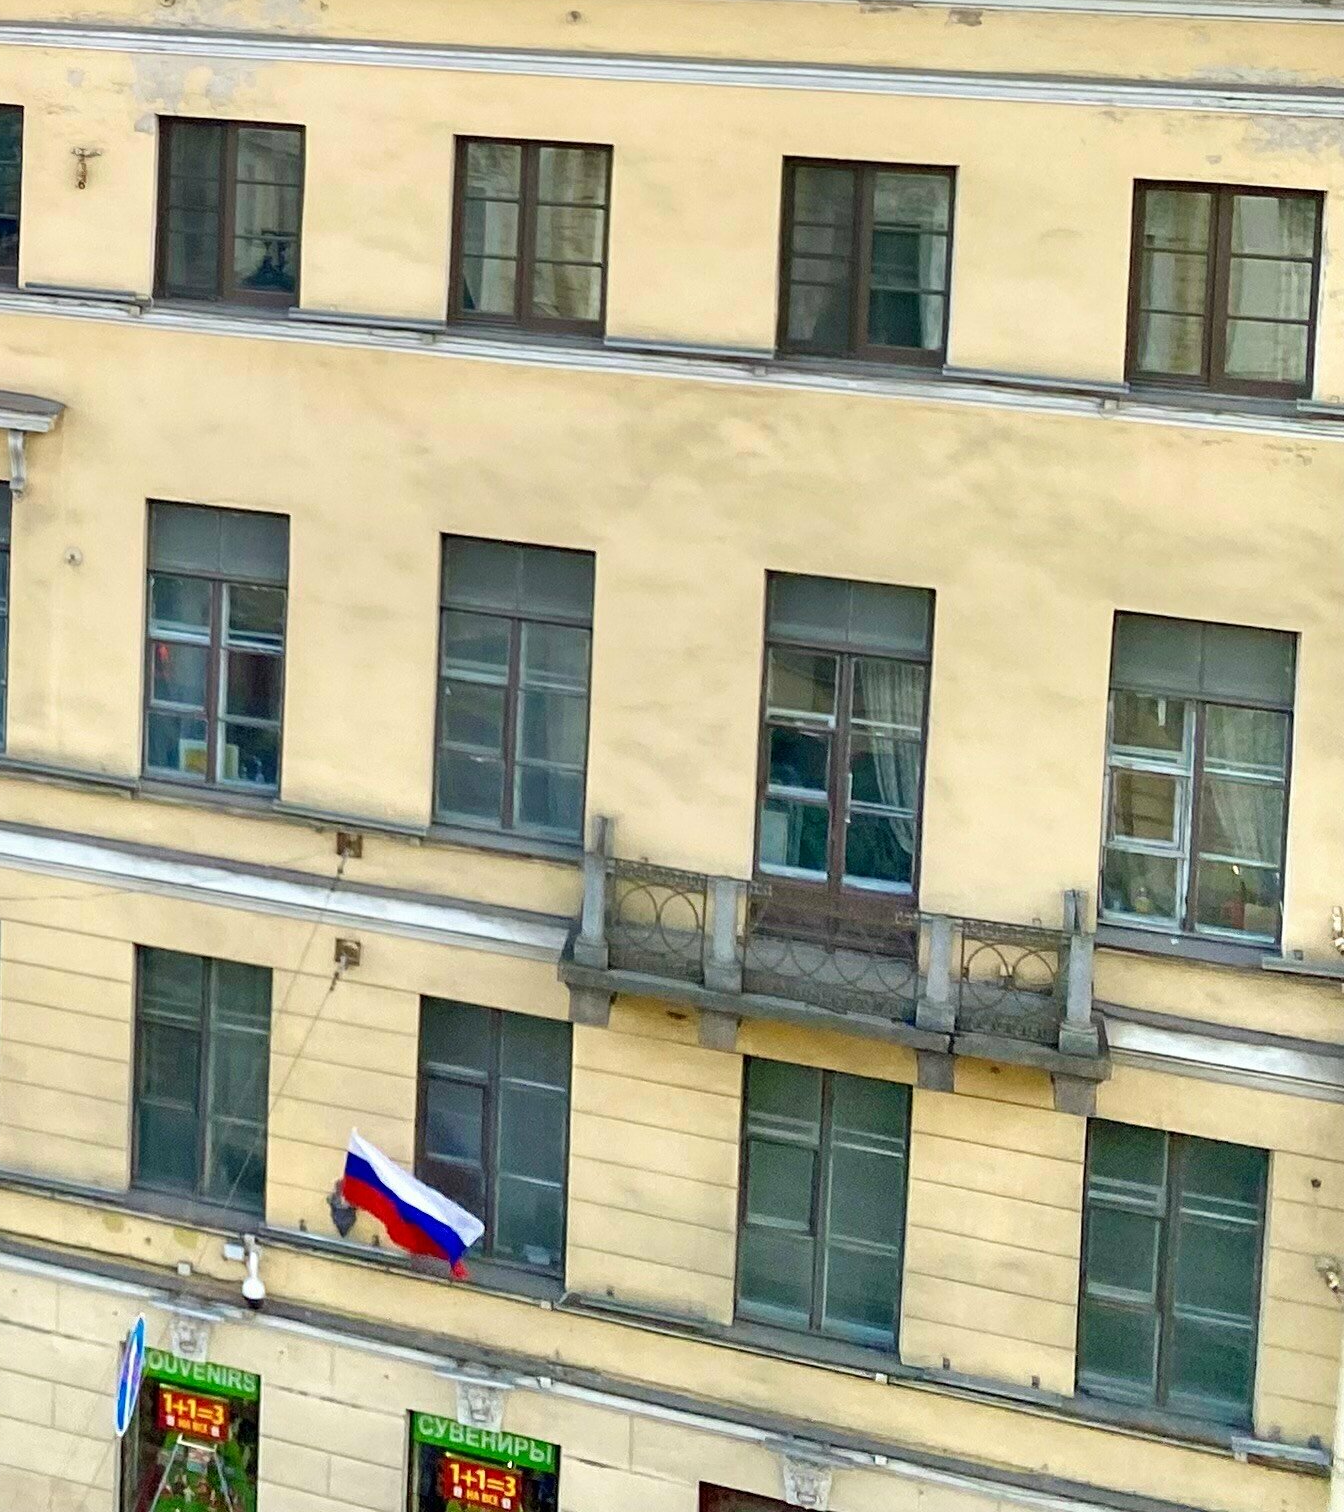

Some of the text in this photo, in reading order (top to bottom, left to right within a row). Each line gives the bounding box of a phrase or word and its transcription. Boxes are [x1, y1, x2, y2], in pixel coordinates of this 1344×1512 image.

[148, 1351, 257, 1392] OUVENIRS
[163, 1393, 224, 1426] 1+1=3
[417, 1415, 553, 1465] СУВЕНИРЫ
[450, 1463, 517, 1498] 1+1=3
